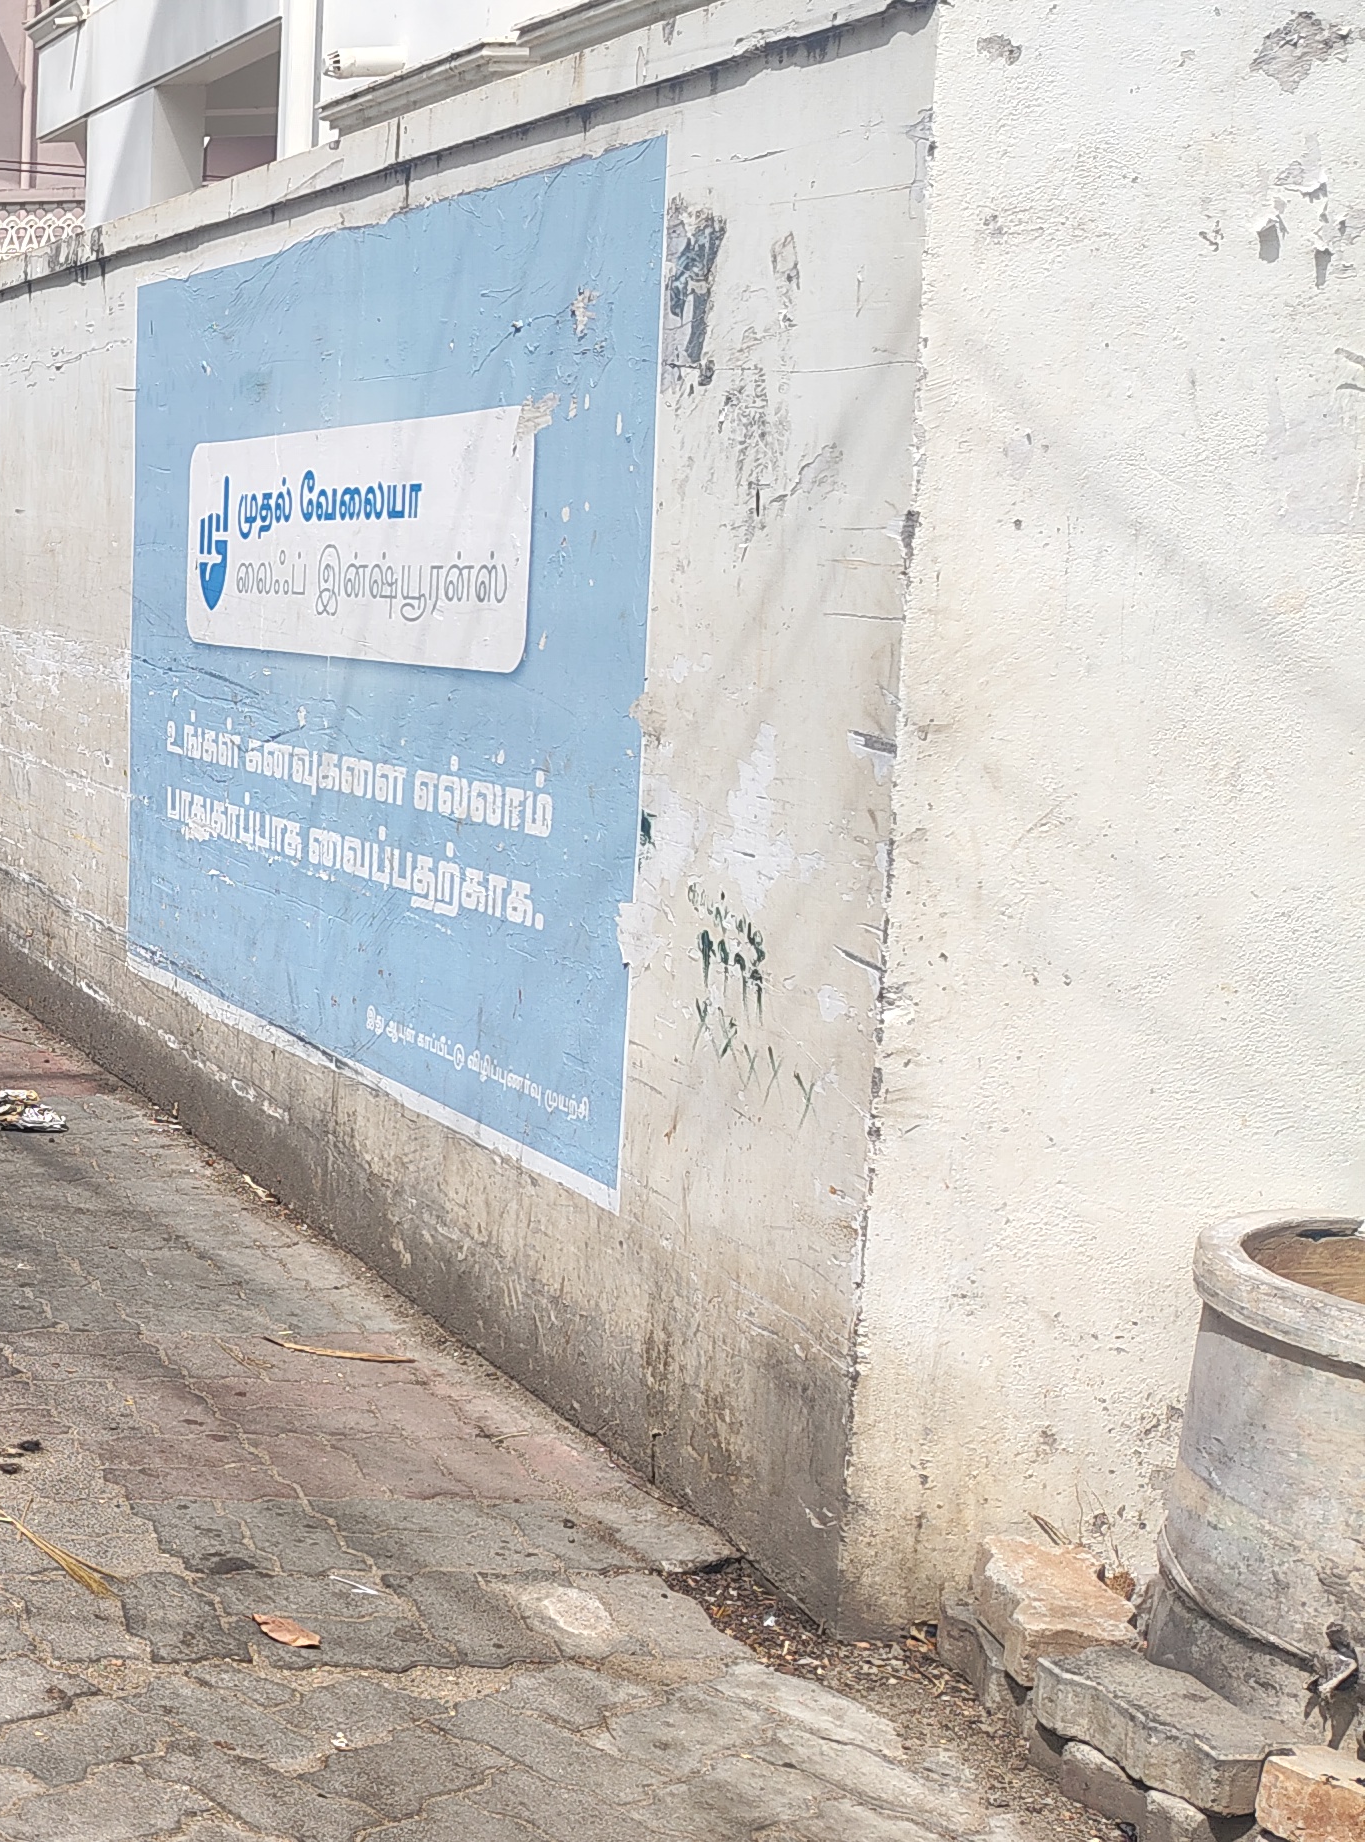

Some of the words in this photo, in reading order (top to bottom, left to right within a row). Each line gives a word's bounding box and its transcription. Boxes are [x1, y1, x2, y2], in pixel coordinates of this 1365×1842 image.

[238, 477, 293, 539] முதல்
[299, 470, 423, 522] வேலையா
[236, 549, 307, 597] லைஃப்
[315, 543, 509, 623] இன்ஷ்யூரன்ஸ்
[166, 709, 241, 769] உங்கள்
[245, 738, 407, 805] கனவுகளை
[414, 755, 553, 838] எல்லாம்
[167, 786, 303, 859] பாதுகாப்பாக
[308, 825, 544, 931] வைப்பதற்காக.
[366, 1005, 385, 1035] இது
[386, 1020, 416, 1046] ஆயுள்
[467, 1050, 542, 1107] விழிப்புணர்வு
[545, 1089, 590, 1121] முயற்சி
